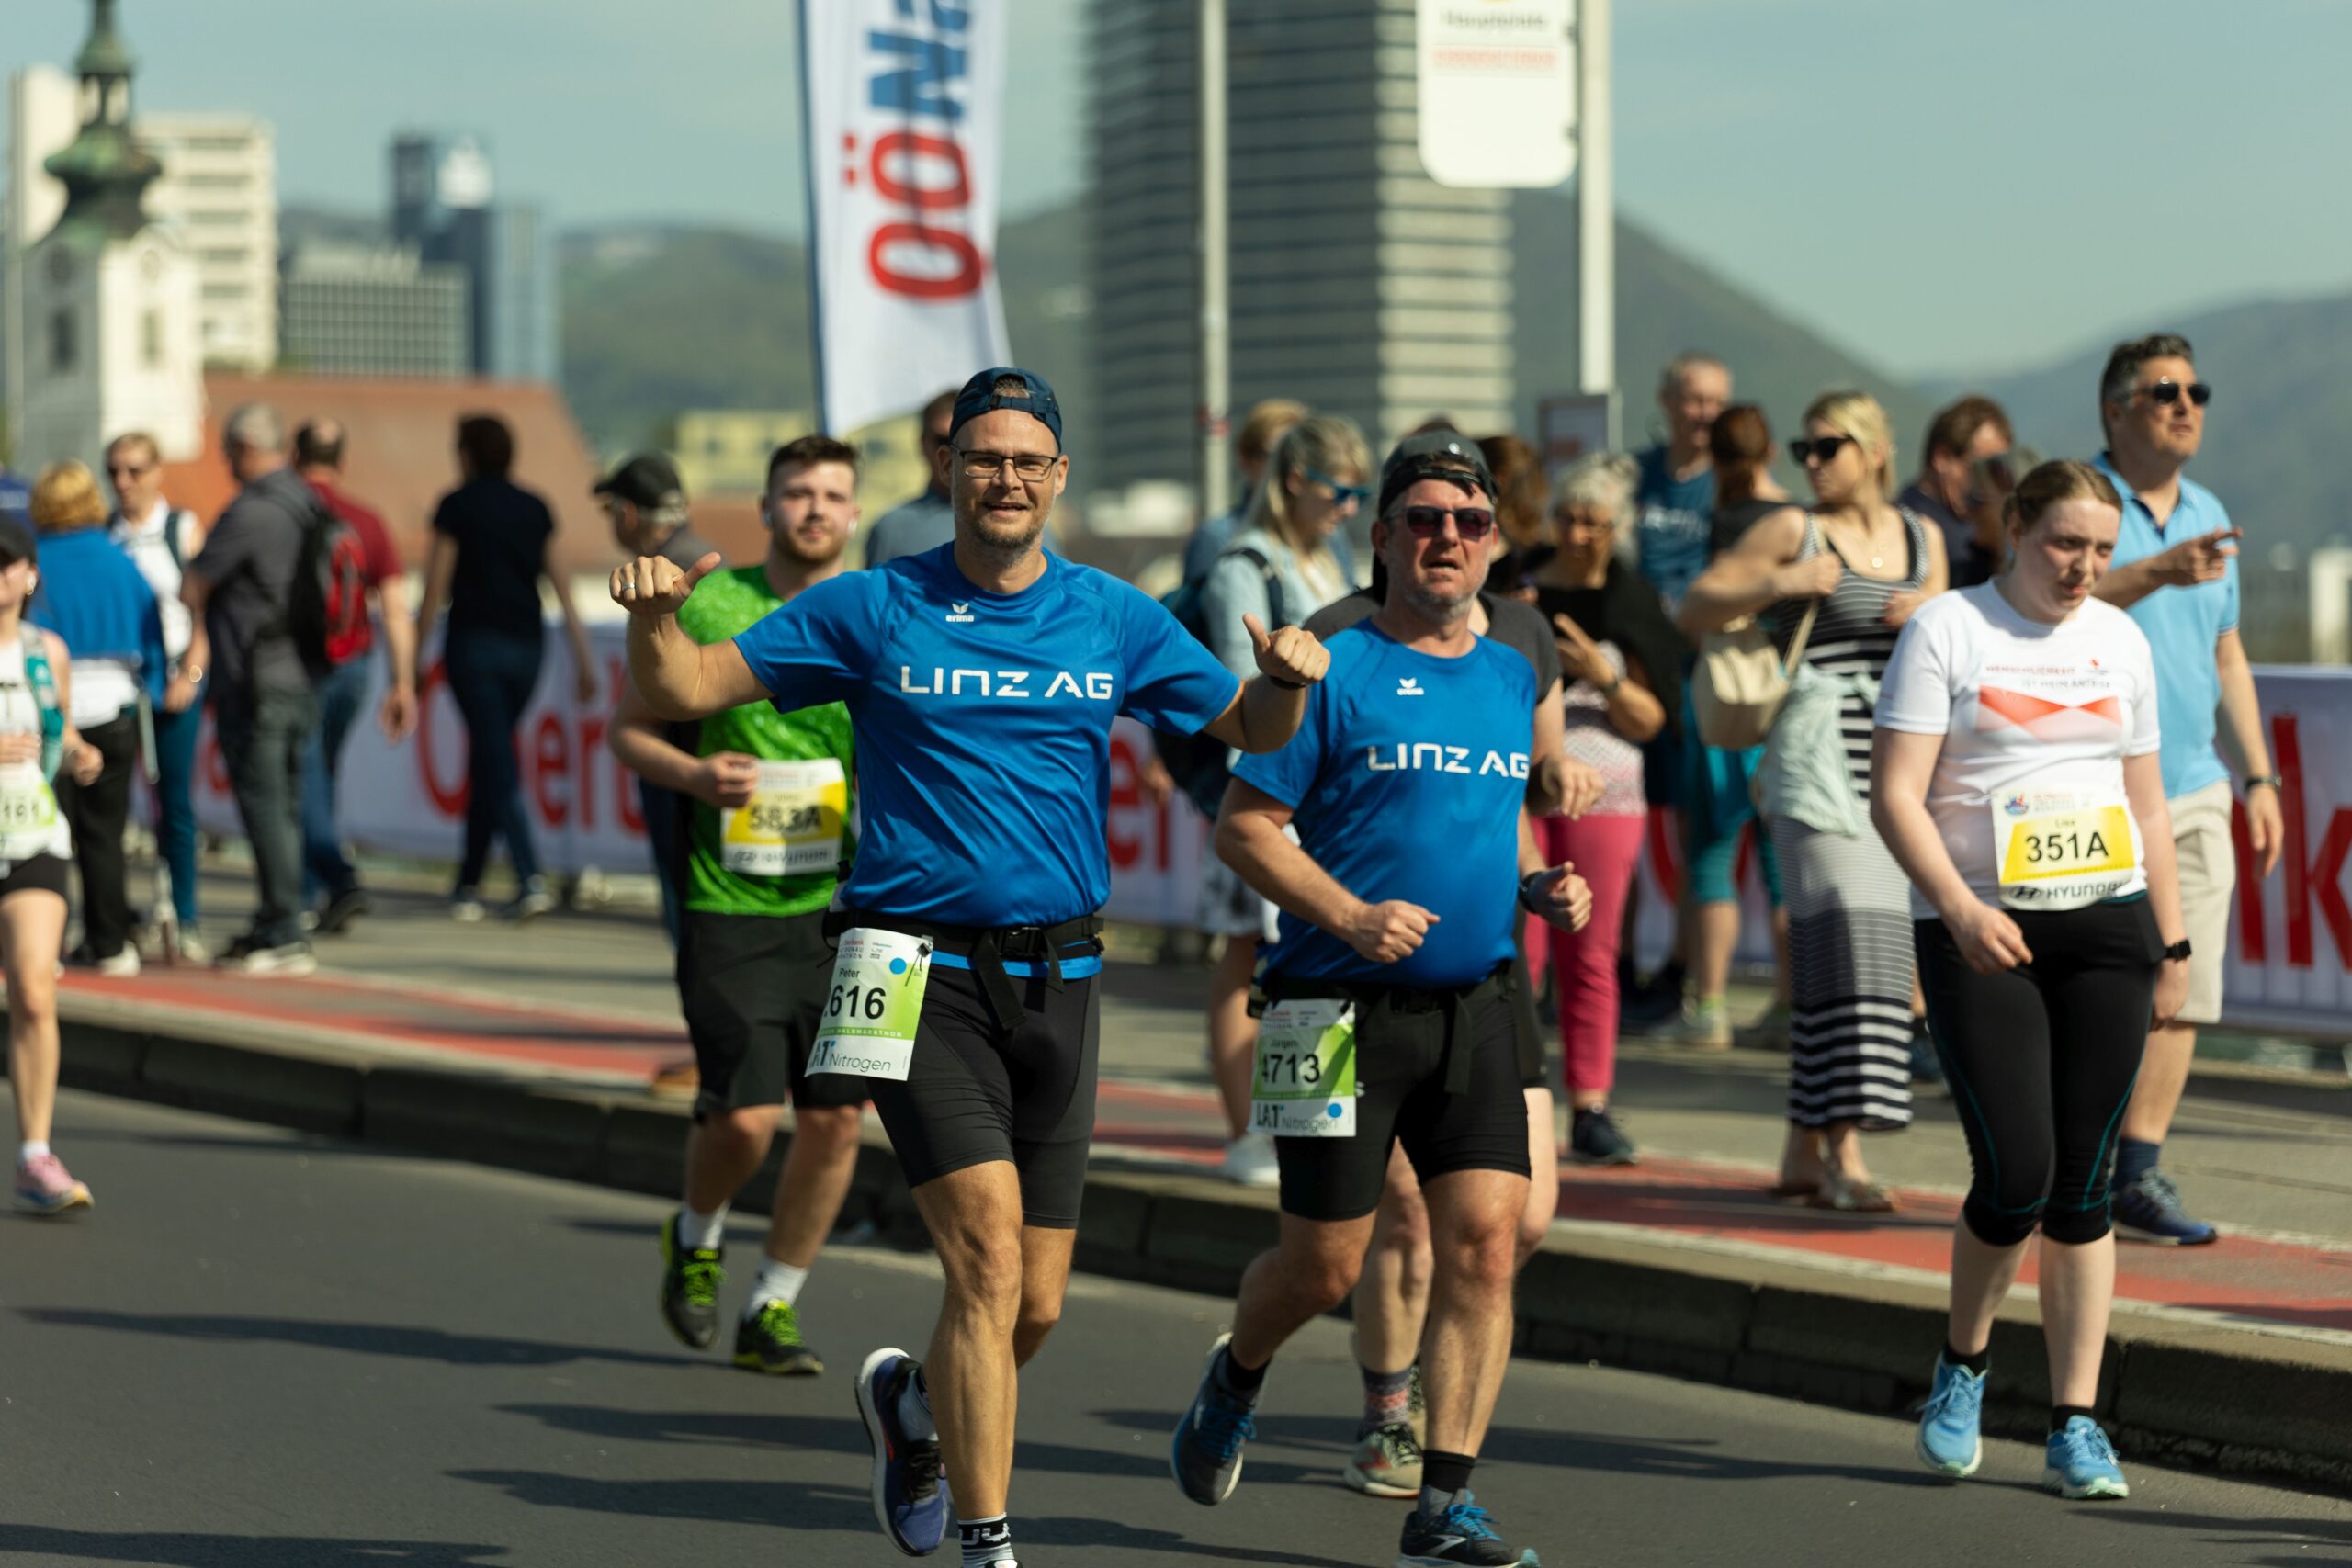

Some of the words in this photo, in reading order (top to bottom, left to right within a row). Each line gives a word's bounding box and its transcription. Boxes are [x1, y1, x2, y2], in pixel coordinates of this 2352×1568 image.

[945, 614, 975, 623] erima
[901, 665, 1030, 697] LINZ
[1044, 671, 1114, 700] AG
[1367, 742, 1470, 774] LINZ
[1478, 750, 1529, 780] AG
[750, 804, 822, 831] 583A
[2026, 831, 2109, 862] 351A
[839, 967, 860, 978] Peter
[824, 984, 886, 1019] 616
[829, 1053, 891, 1072] Nitrogen
